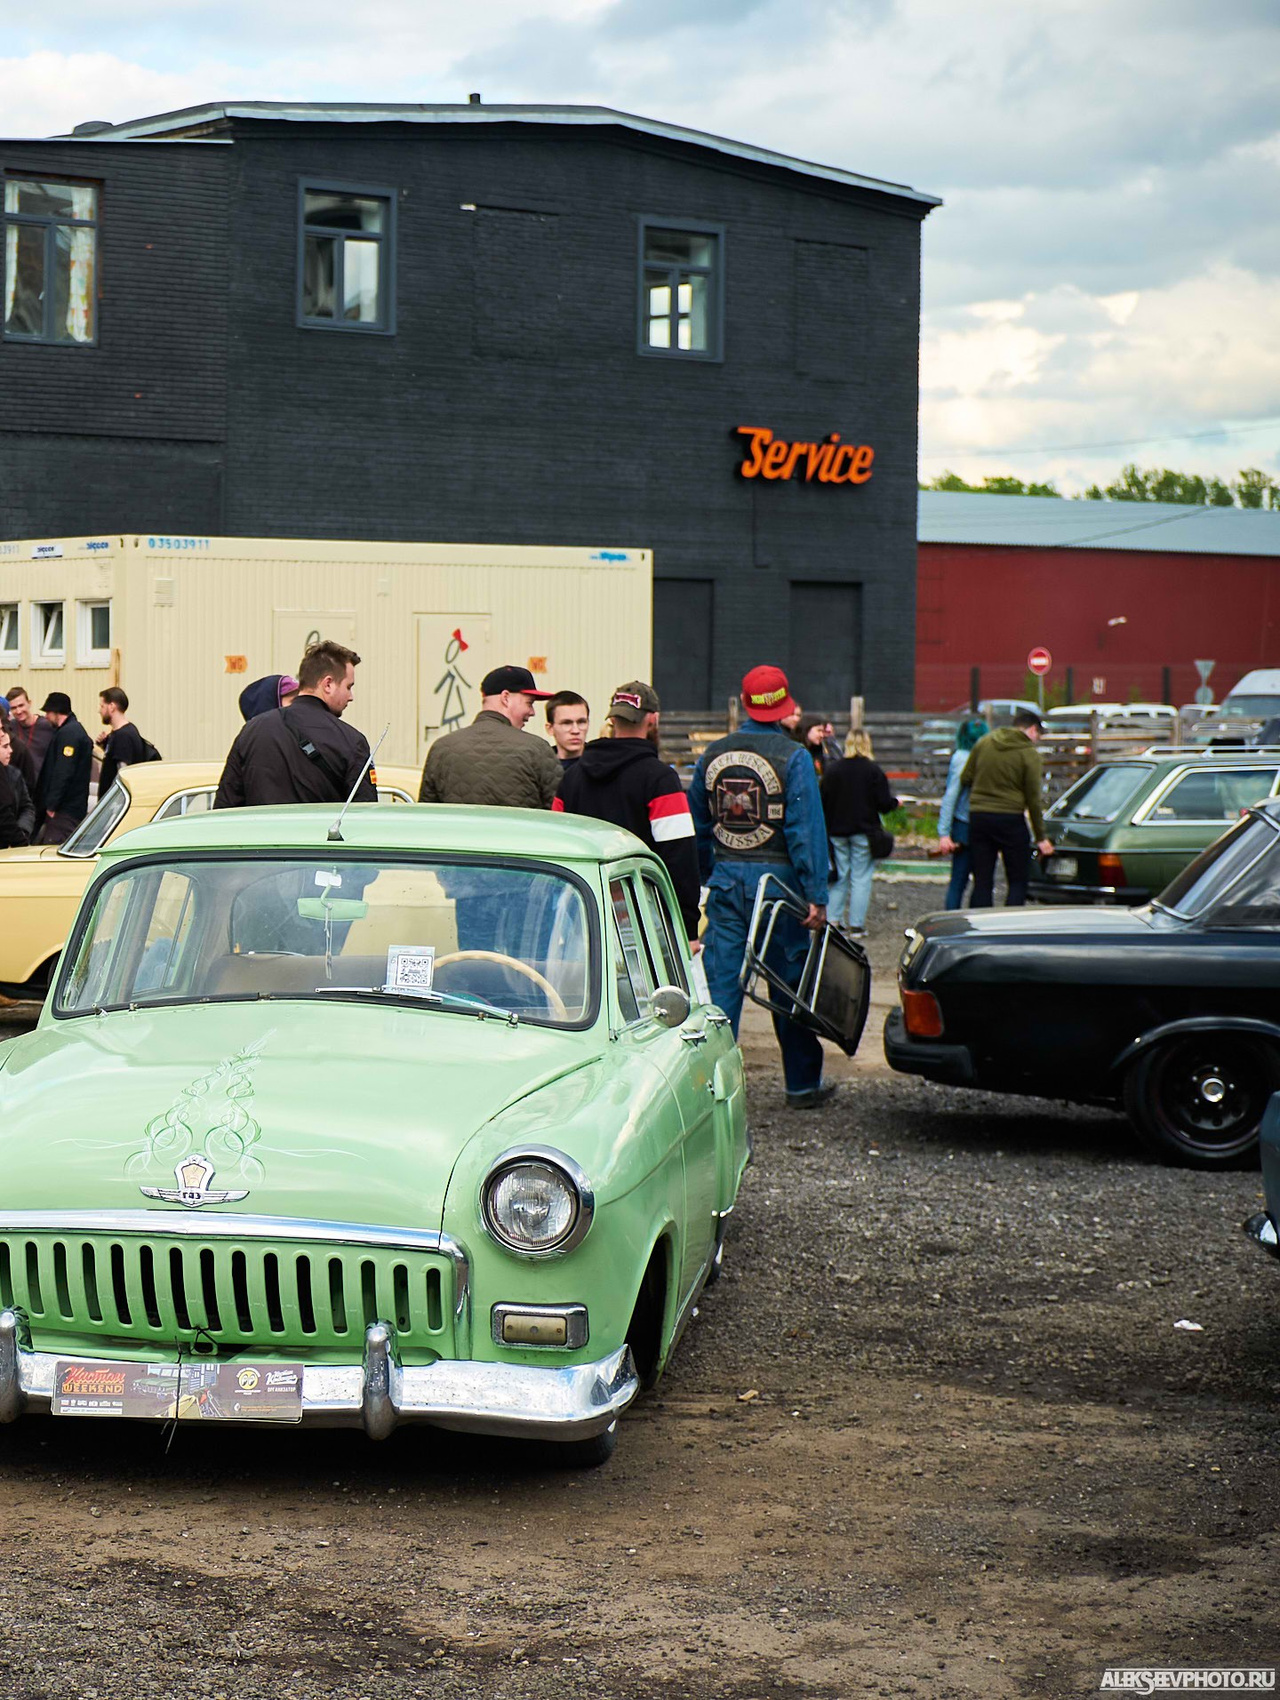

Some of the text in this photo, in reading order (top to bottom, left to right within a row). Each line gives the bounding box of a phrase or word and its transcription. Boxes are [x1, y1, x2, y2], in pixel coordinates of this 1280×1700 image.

[736, 425, 875, 485] Service
[148, 537, 210, 550] 03503911
[714, 827, 771, 848] RUSSIA
[62, 1384, 124, 1394] WEEKEND
